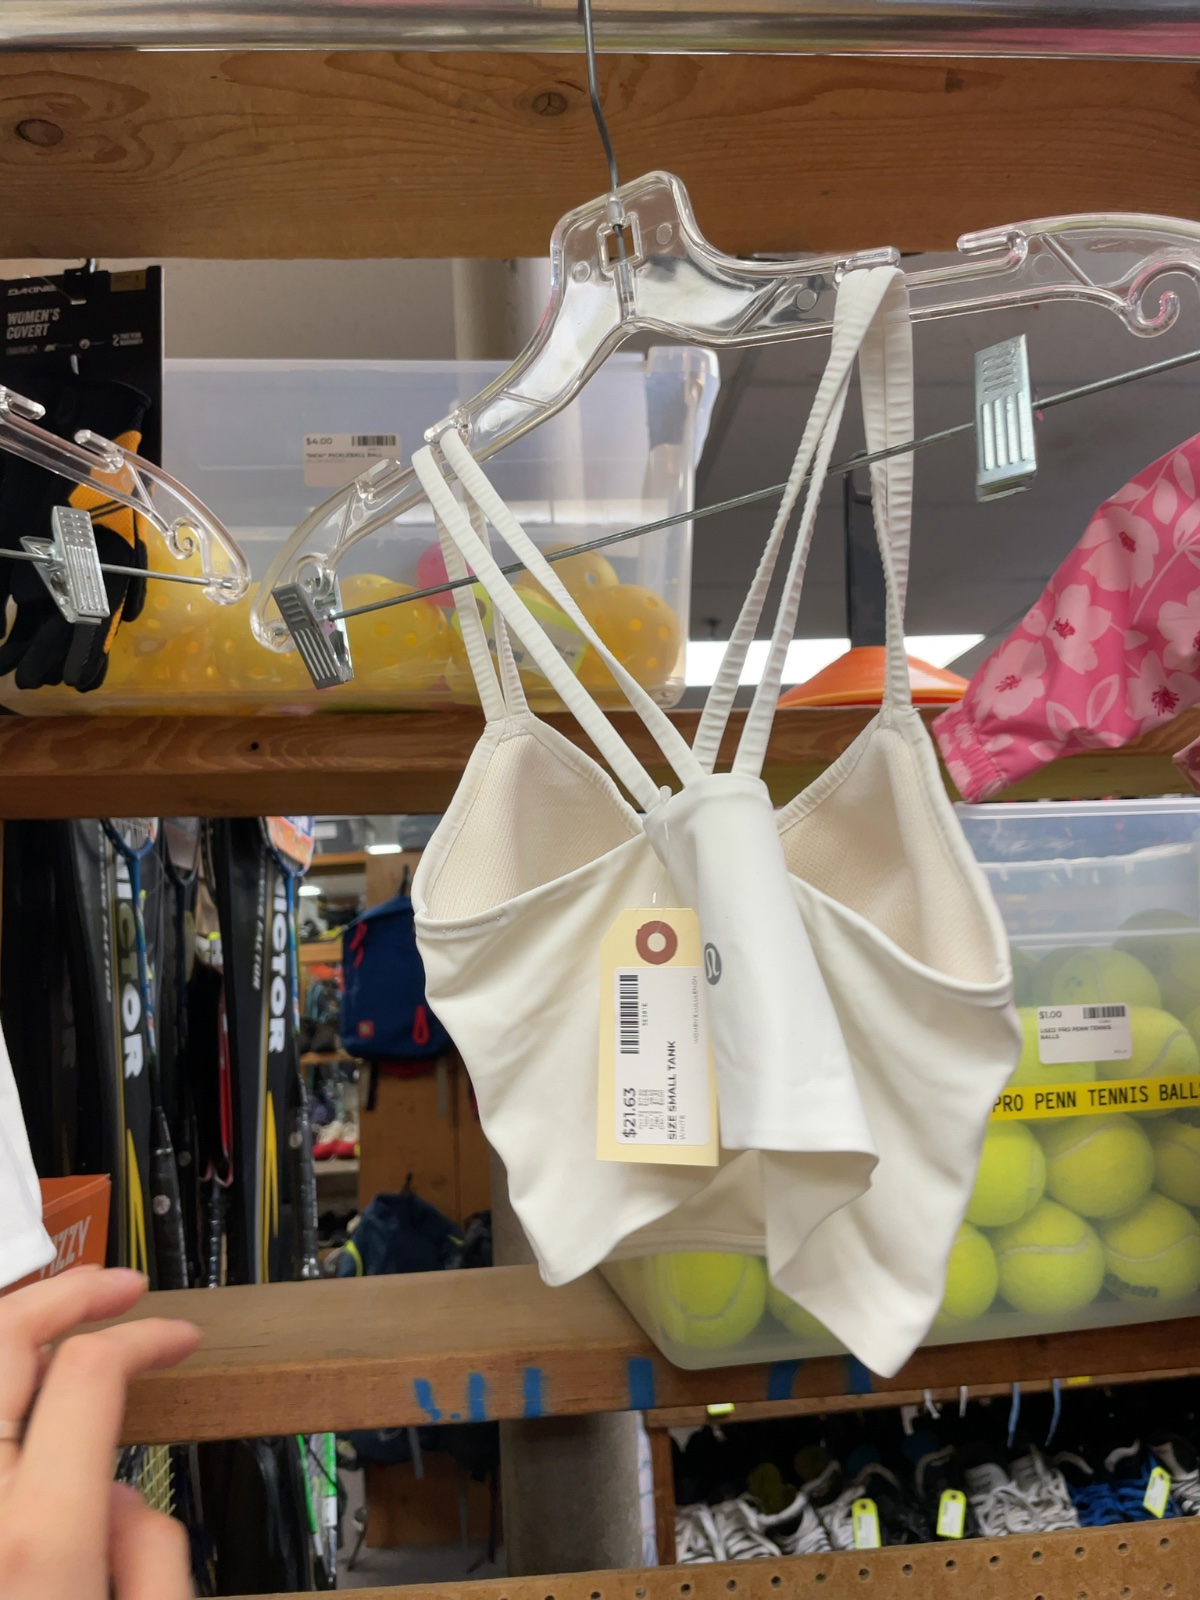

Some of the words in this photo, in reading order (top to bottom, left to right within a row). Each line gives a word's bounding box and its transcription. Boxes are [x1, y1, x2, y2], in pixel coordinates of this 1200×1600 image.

[7, 284, 57, 297] DAKINE
[7, 307, 61, 325] WOMEN'S
[6, 323, 50, 340] COVERT
[306, 437, 333, 446] $4.00
[1039, 1010, 1062, 1019] $1.00
[666, 1040, 676, 1071] TANK
[667, 1073, 677, 1112] SMALL
[993, 1094, 1023, 1113] PRO
[1034, 1090, 1077, 1110] PENN
[1088, 1085, 1149, 1107] TENNIS
[1158, 1081, 1200, 1101] BALL
[621, 1087, 638, 1138] $21.63
[667, 1116, 677, 1140] SIZE
